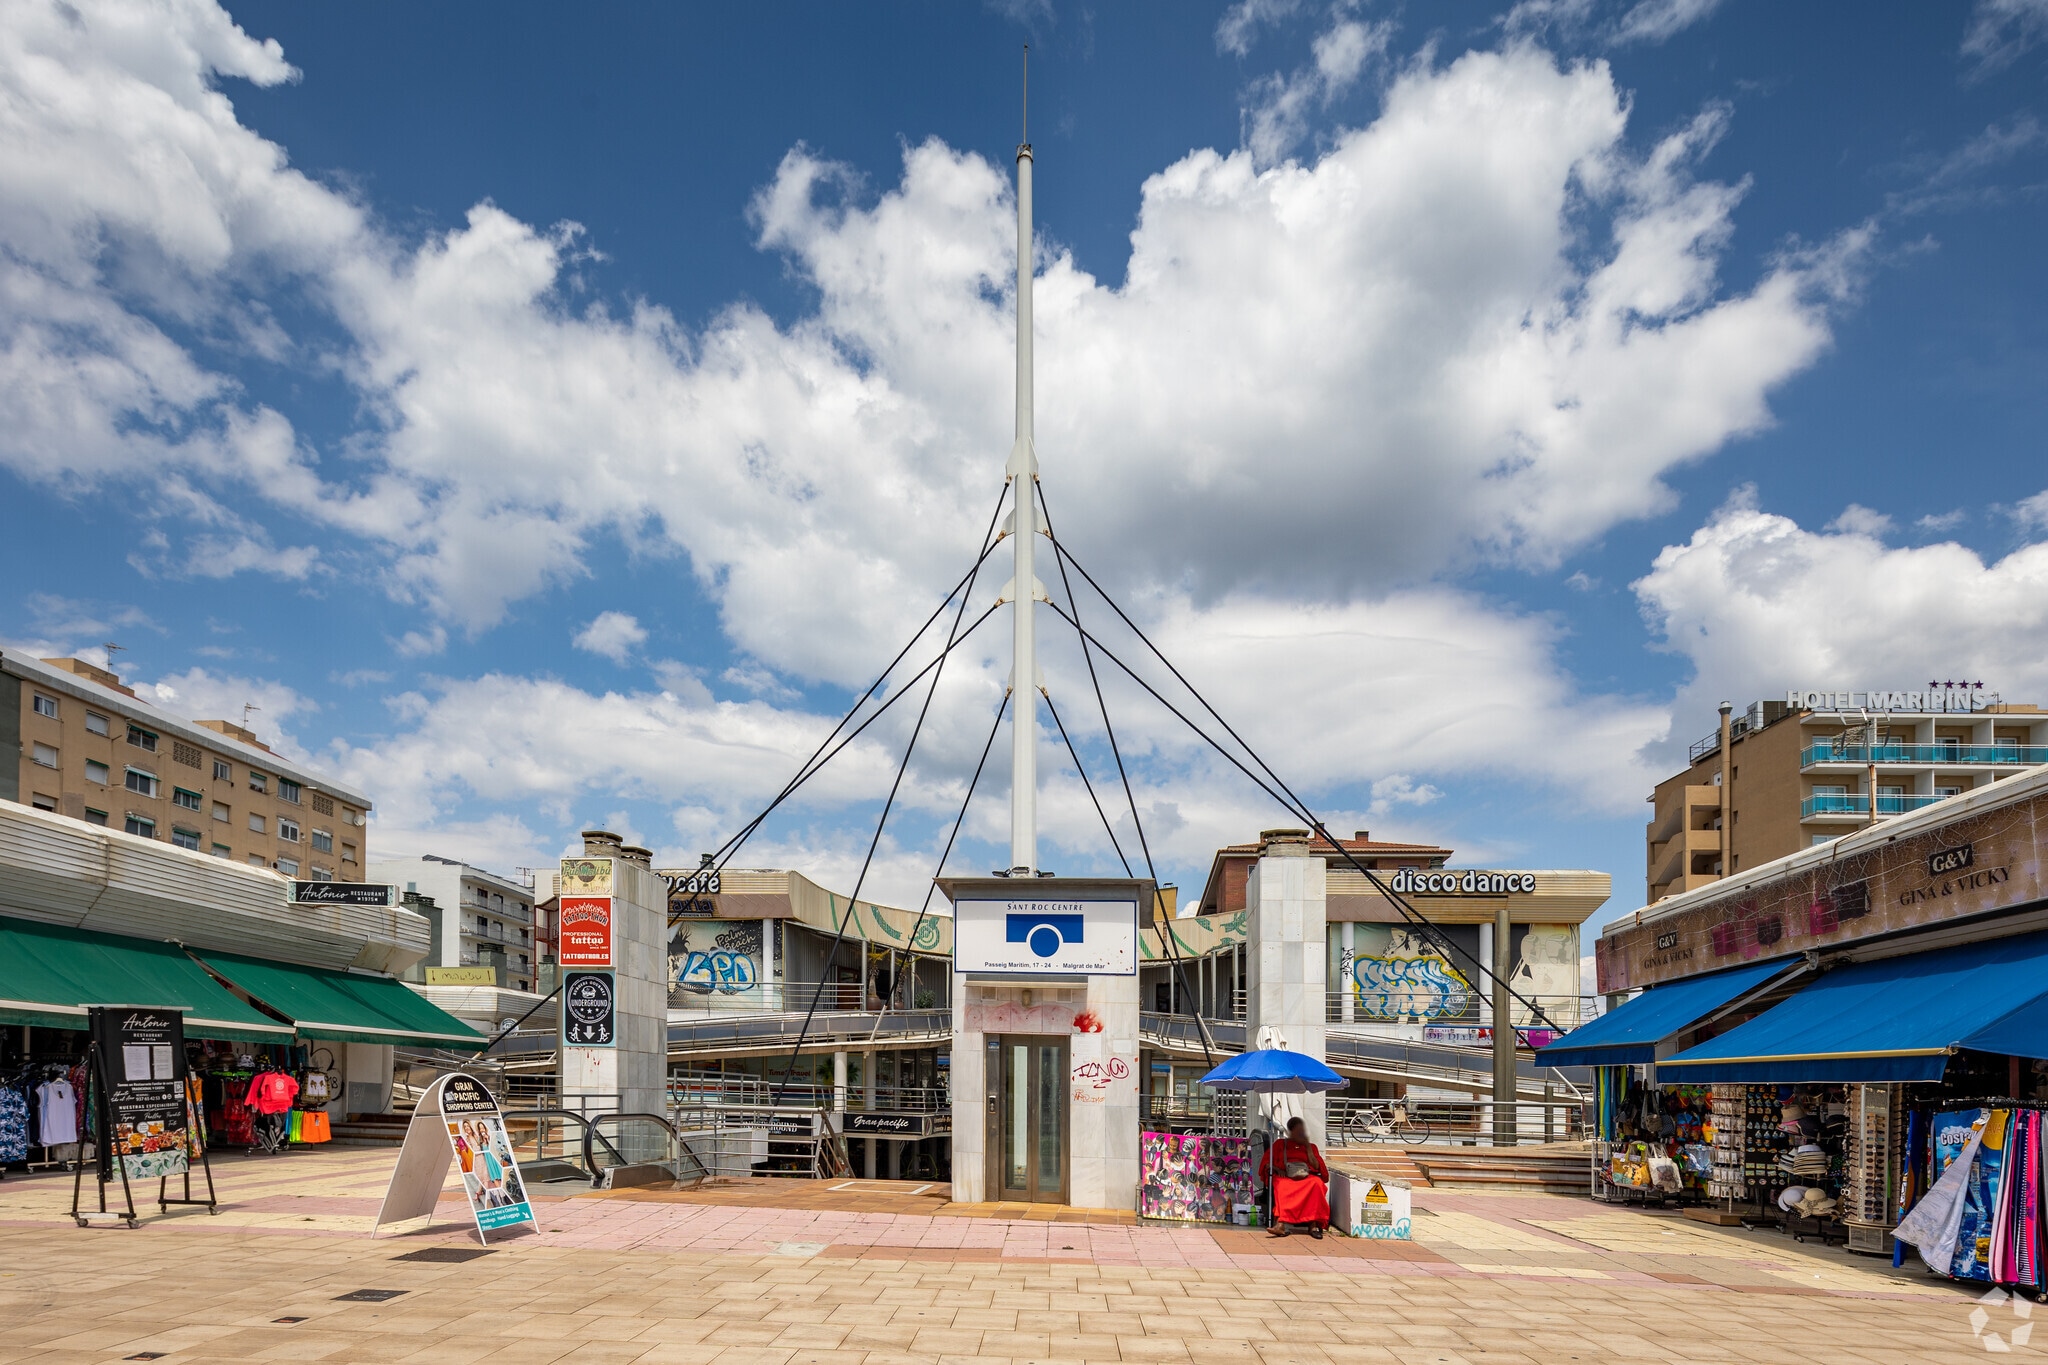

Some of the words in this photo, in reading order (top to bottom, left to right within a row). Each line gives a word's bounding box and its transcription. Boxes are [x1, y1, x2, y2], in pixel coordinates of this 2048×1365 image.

[1786, 689, 1862, 709] HOTEL
[1865, 690, 1988, 711] MARIPINS
[1931, 848, 1969, 873] G&V
[676, 872, 720, 893] café
[1391, 869, 1457, 893] disco
[1460, 869, 1536, 893] dance
[1899, 886, 1937, 906] GINA
[1941, 881, 1953, 896] &
[1957, 866, 2012, 892] VICKY
[300, 884, 348, 900] Antonio
[1007, 903, 1028, 911] SANT
[1032, 903, 1049, 911] ROC
[1051, 903, 1084, 911] CENTRE
[563, 911, 589, 926] TATTOO
[590, 911, 609, 926] THOR
[571, 936, 604, 945] tattoo
[716, 929, 746, 945] Palm
[724, 935, 757, 950] Beach
[1659, 934, 1676, 949] G&V
[1644, 957, 1662, 969] GINA
[1669, 946, 1695, 962] VICKY
[571, 999, 608, 1007] UNDERGROUND
[122, 1013, 170, 1030] Antonio
[454, 1082, 474, 1091] GRAN
[453, 1092, 480, 1101] PACIFIC
[446, 1103, 473, 1111] SHOPPING
[854, 1115, 876, 1128] Gran
[877, 1118, 909, 1129] pacific
